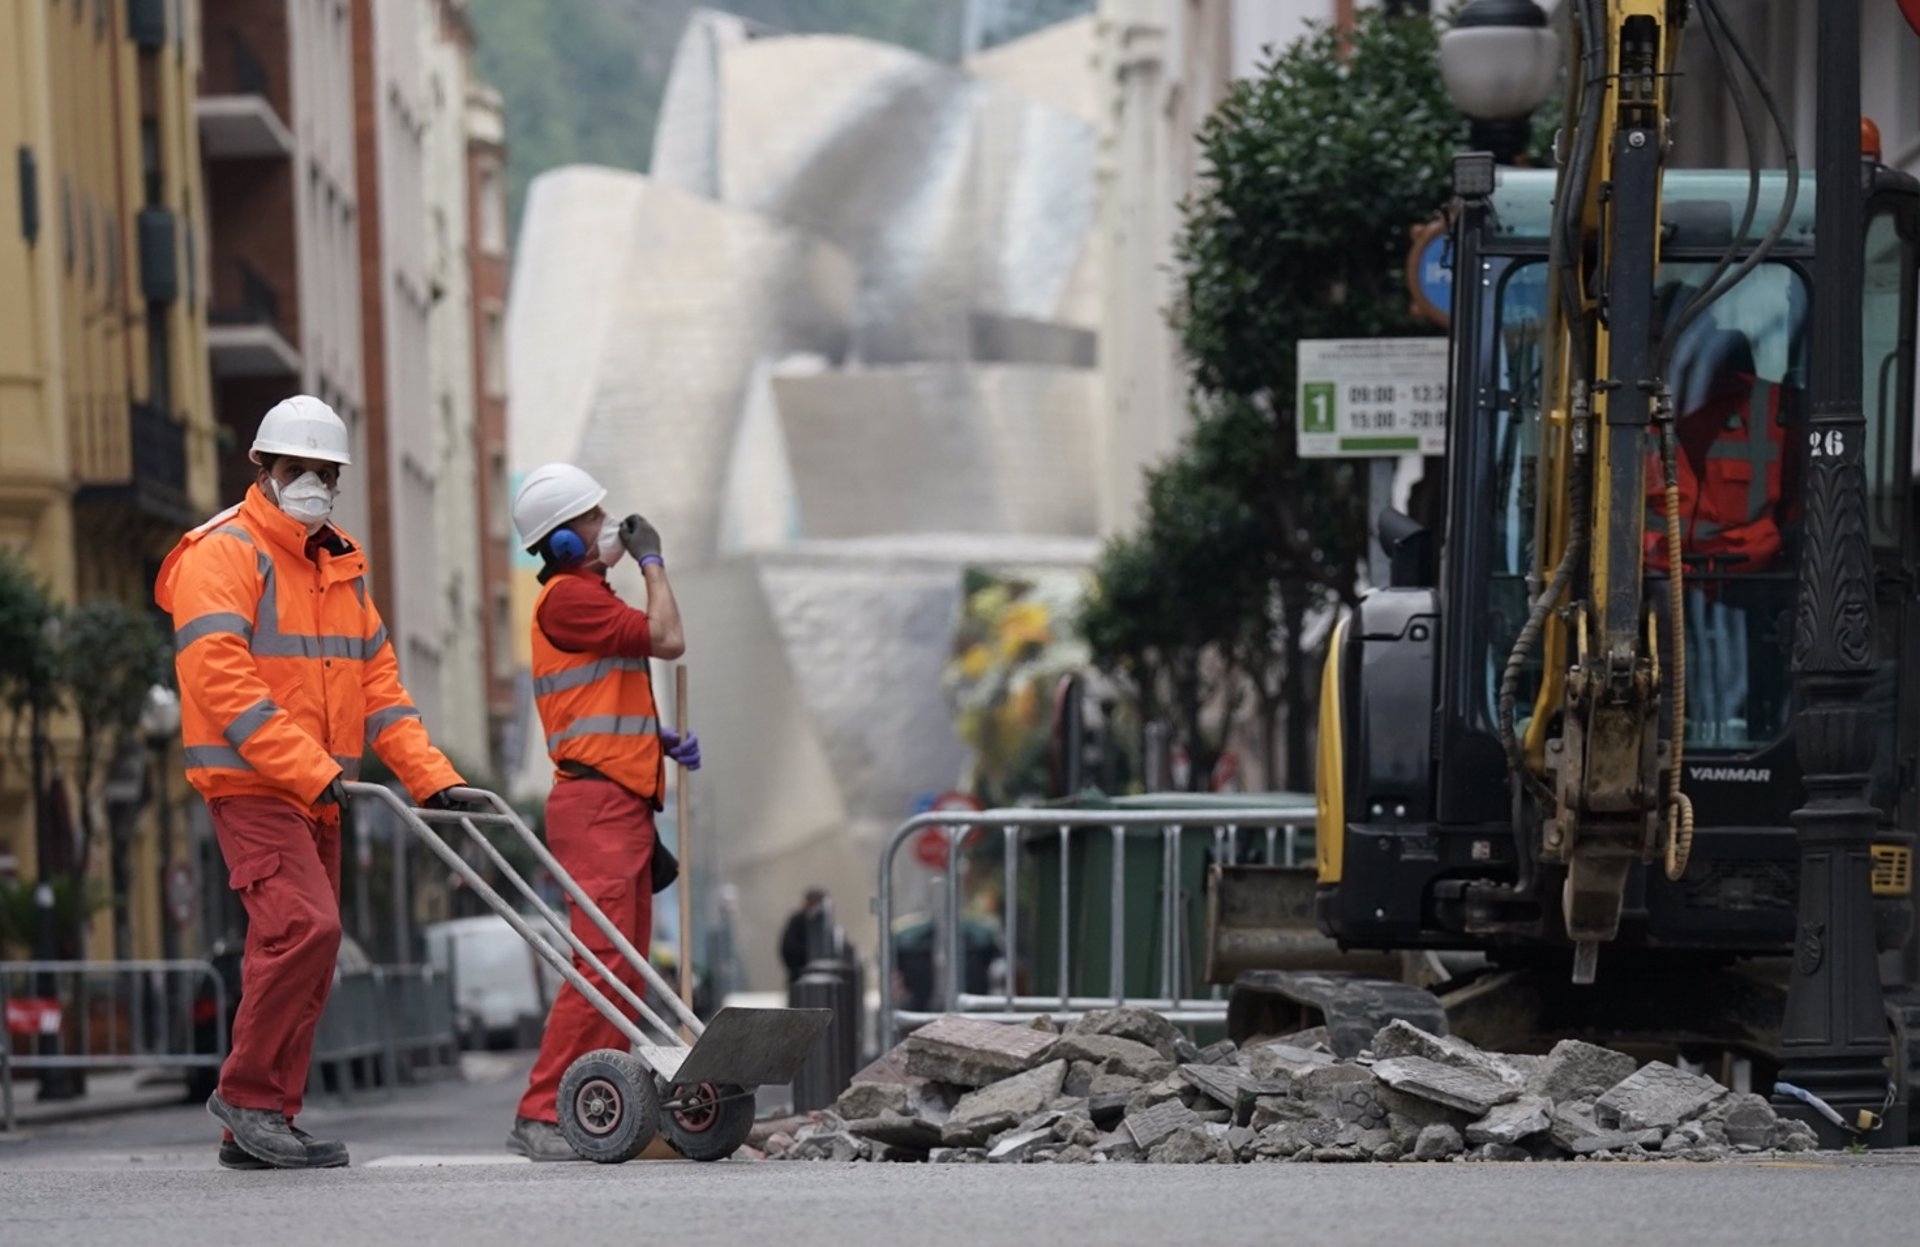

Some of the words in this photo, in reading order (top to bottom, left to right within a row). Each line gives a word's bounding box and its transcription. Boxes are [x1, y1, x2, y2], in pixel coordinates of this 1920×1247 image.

[1312, 393, 1328, 423] 1
[1410, 409, 1446, 428] 20:0
[1809, 430, 1844, 457] 26
[1689, 767, 1771, 781] YANMAR
